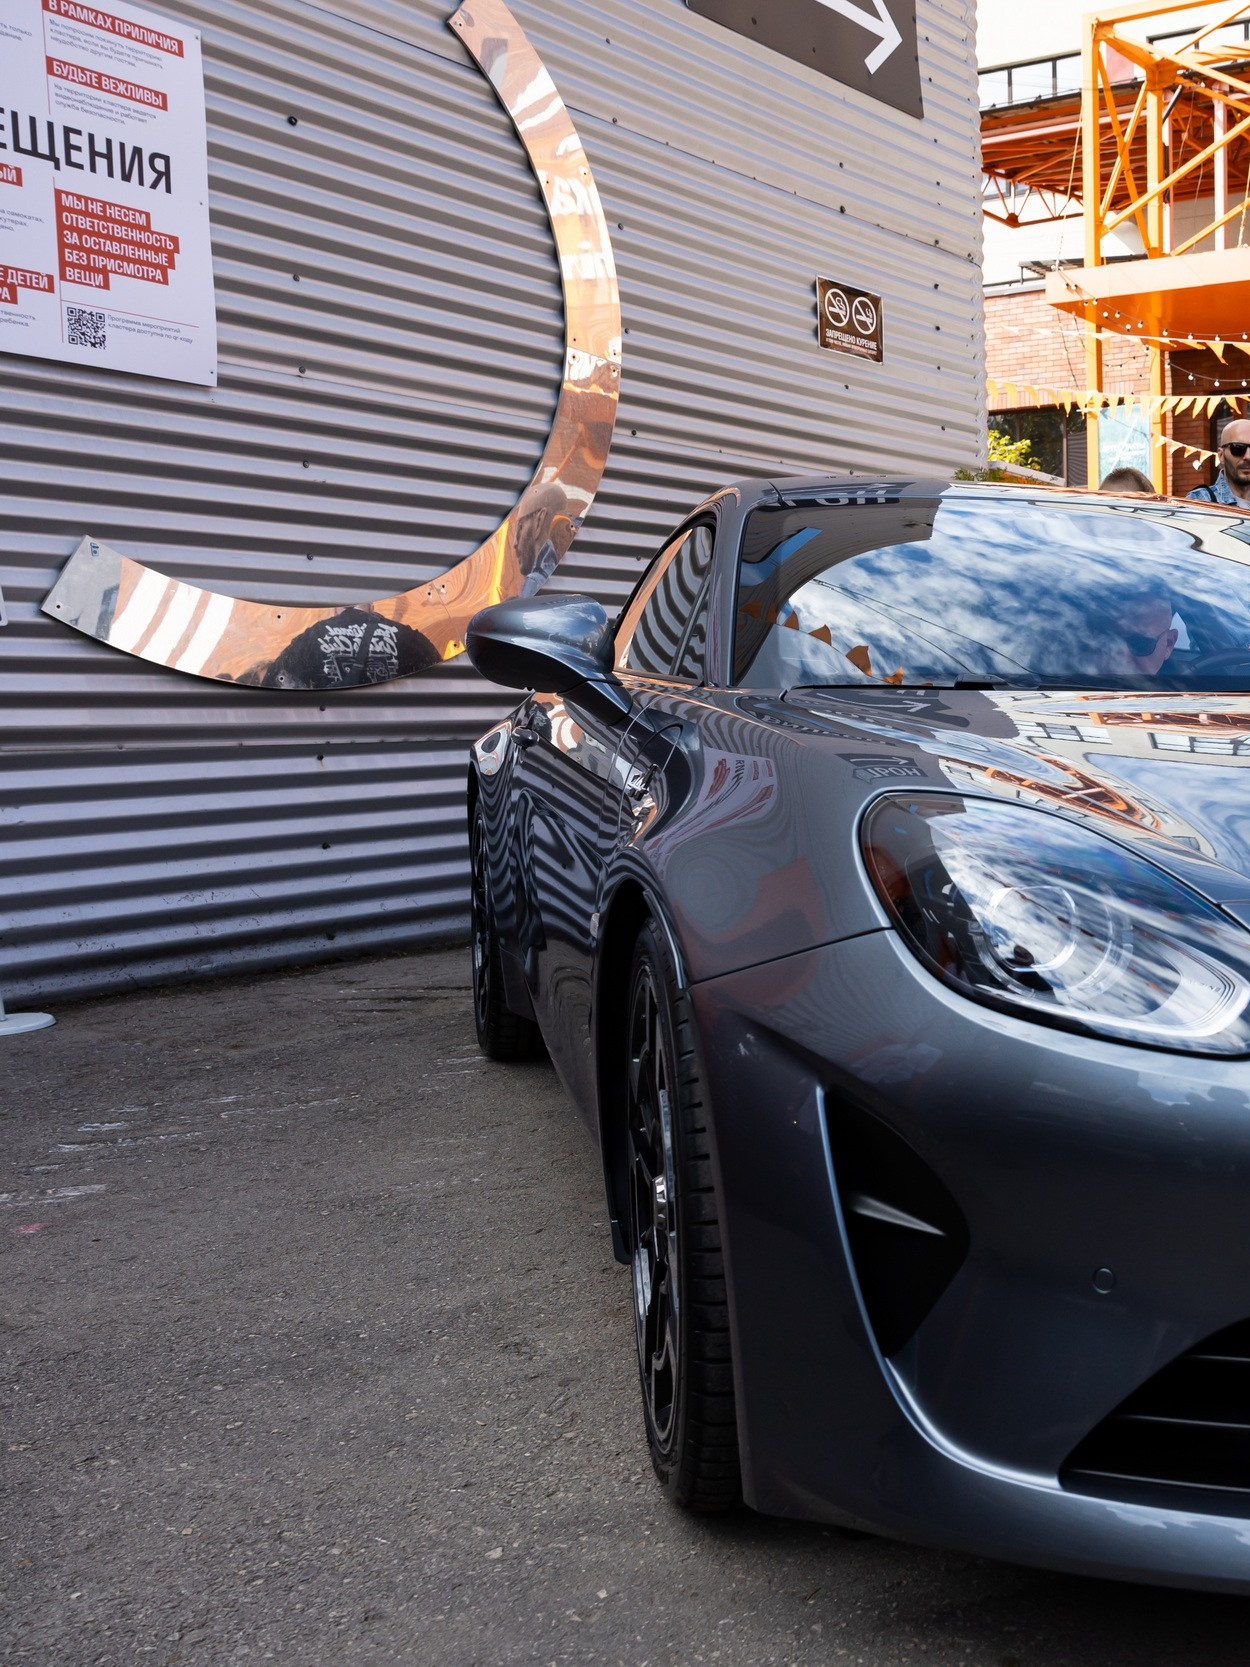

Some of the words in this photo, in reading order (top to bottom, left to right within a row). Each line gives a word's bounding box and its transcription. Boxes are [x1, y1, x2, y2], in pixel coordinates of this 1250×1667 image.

[48, 0, 57, 10] В
[61, 4, 112, 30] РАМКАХ
[116, 21, 178, 53] ПРИЛИЧИЯ
[53, 62, 98, 87] БУДЬТЕ
[102, 78, 162, 106] ВЕЖЛИВЫ
[62, 193, 84, 210] МЫ
[88, 201, 104, 216] НЕ
[106, 206, 147, 226] НЕСЕМ
[62, 212, 174, 250] ОТВЕТСТВЕННОСТЬ
[64, 230, 80, 246] ЗА
[82, 234, 168, 266] ОСТАВЛЕННЫЕ
[7, 269, 48, 290] ДЕТЕЙ
[65, 248, 87, 266] БЕЗ
[90, 254, 164, 282] ПРИСМОТРА
[66, 266, 104, 287] ВЕЩИ
[108, 314, 142, 326] Программа
[142, 322, 180, 334] мероприятий
[108, 324, 136, 333] кластера
[136, 328, 164, 338] доступна
[826, 328, 856, 344] ЗАПРЕЩЕНО
[856, 337, 878, 350] КУРЕНИЕ
